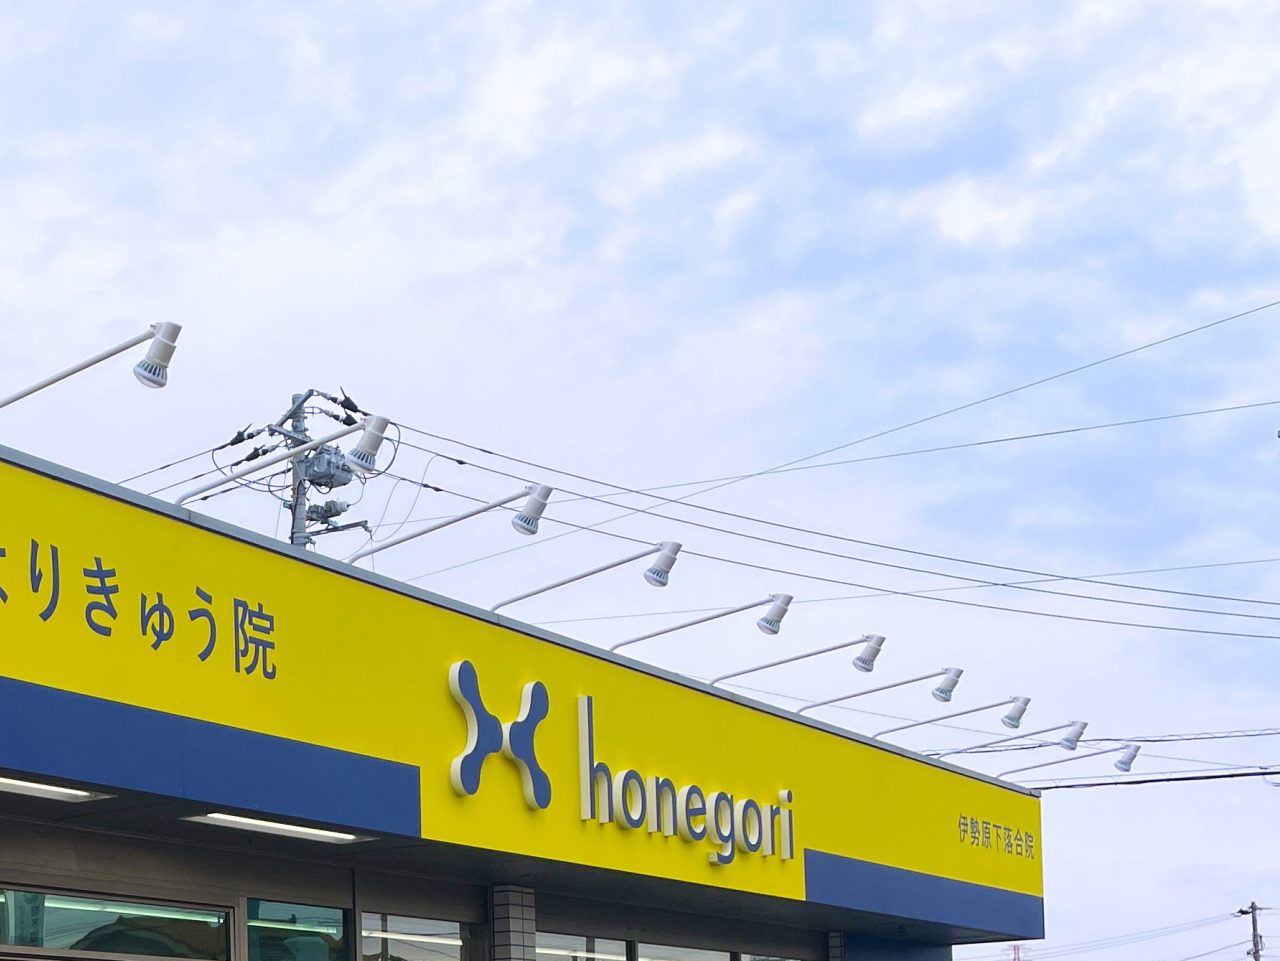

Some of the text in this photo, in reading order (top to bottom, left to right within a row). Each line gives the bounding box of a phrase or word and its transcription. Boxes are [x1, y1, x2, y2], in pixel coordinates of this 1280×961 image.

[578, 694, 795, 866] honegori
[958, 812, 1035, 861] 伊勢原下落合院
